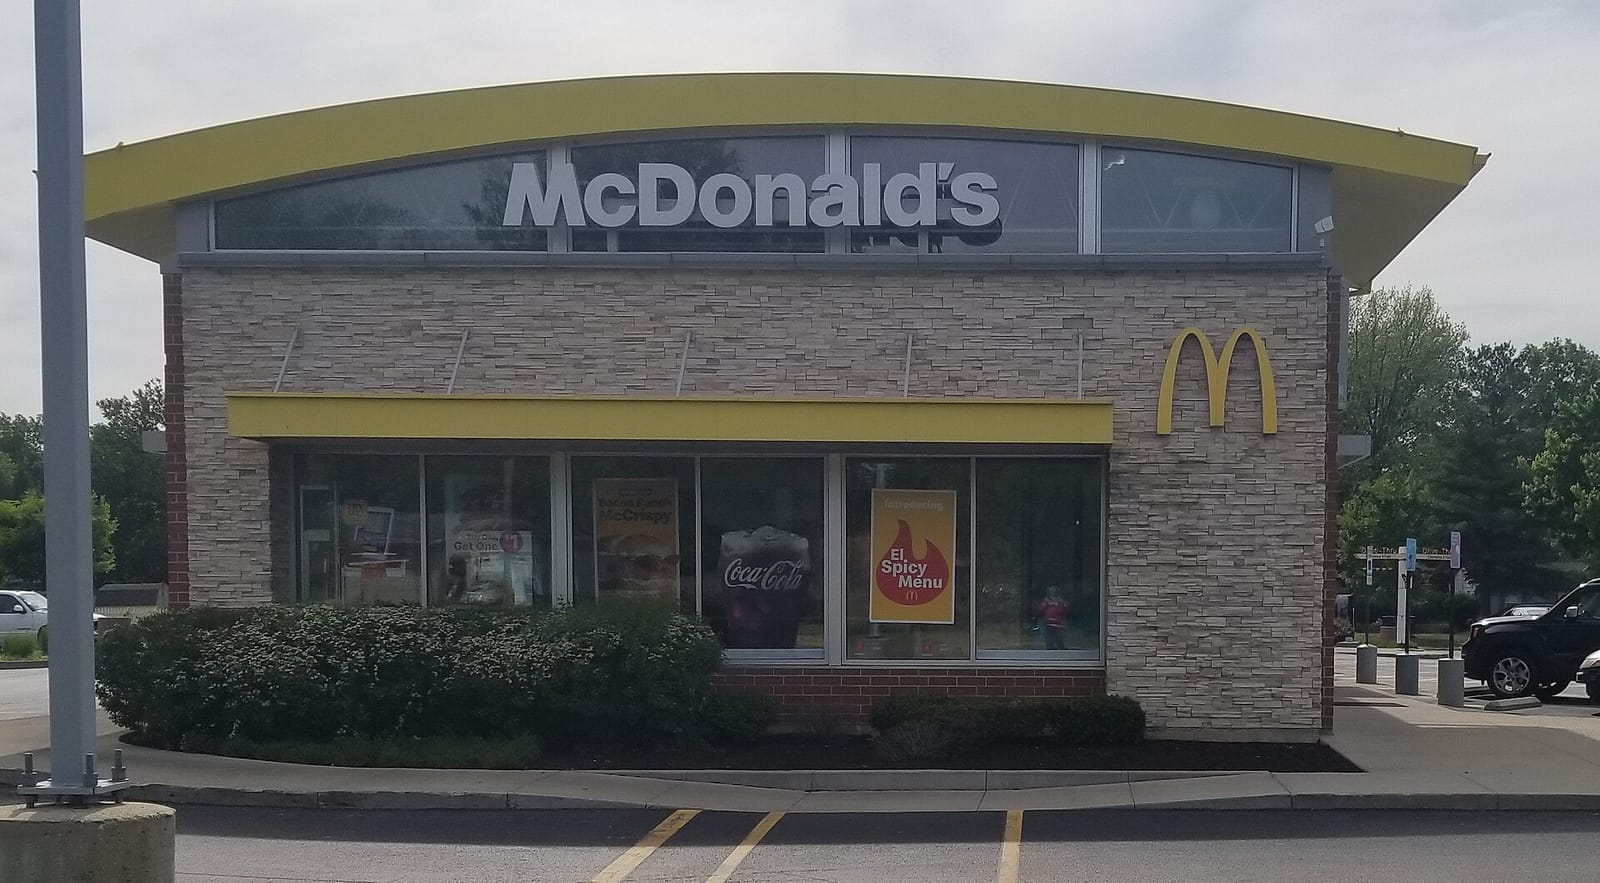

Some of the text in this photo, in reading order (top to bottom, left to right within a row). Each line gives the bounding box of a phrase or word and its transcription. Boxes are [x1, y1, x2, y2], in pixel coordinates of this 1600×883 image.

[502, 162, 1001, 228] McDonald's
[884, 499, 944, 512] Introducing
[600, 508, 672, 525] McCrispy
[454, 541, 498, 551] Get One
[890, 548, 904, 561] El
[724, 558, 804, 590] Coca-Cola
[881, 559, 928, 578] Spicy
[898, 574, 943, 589] Menu
